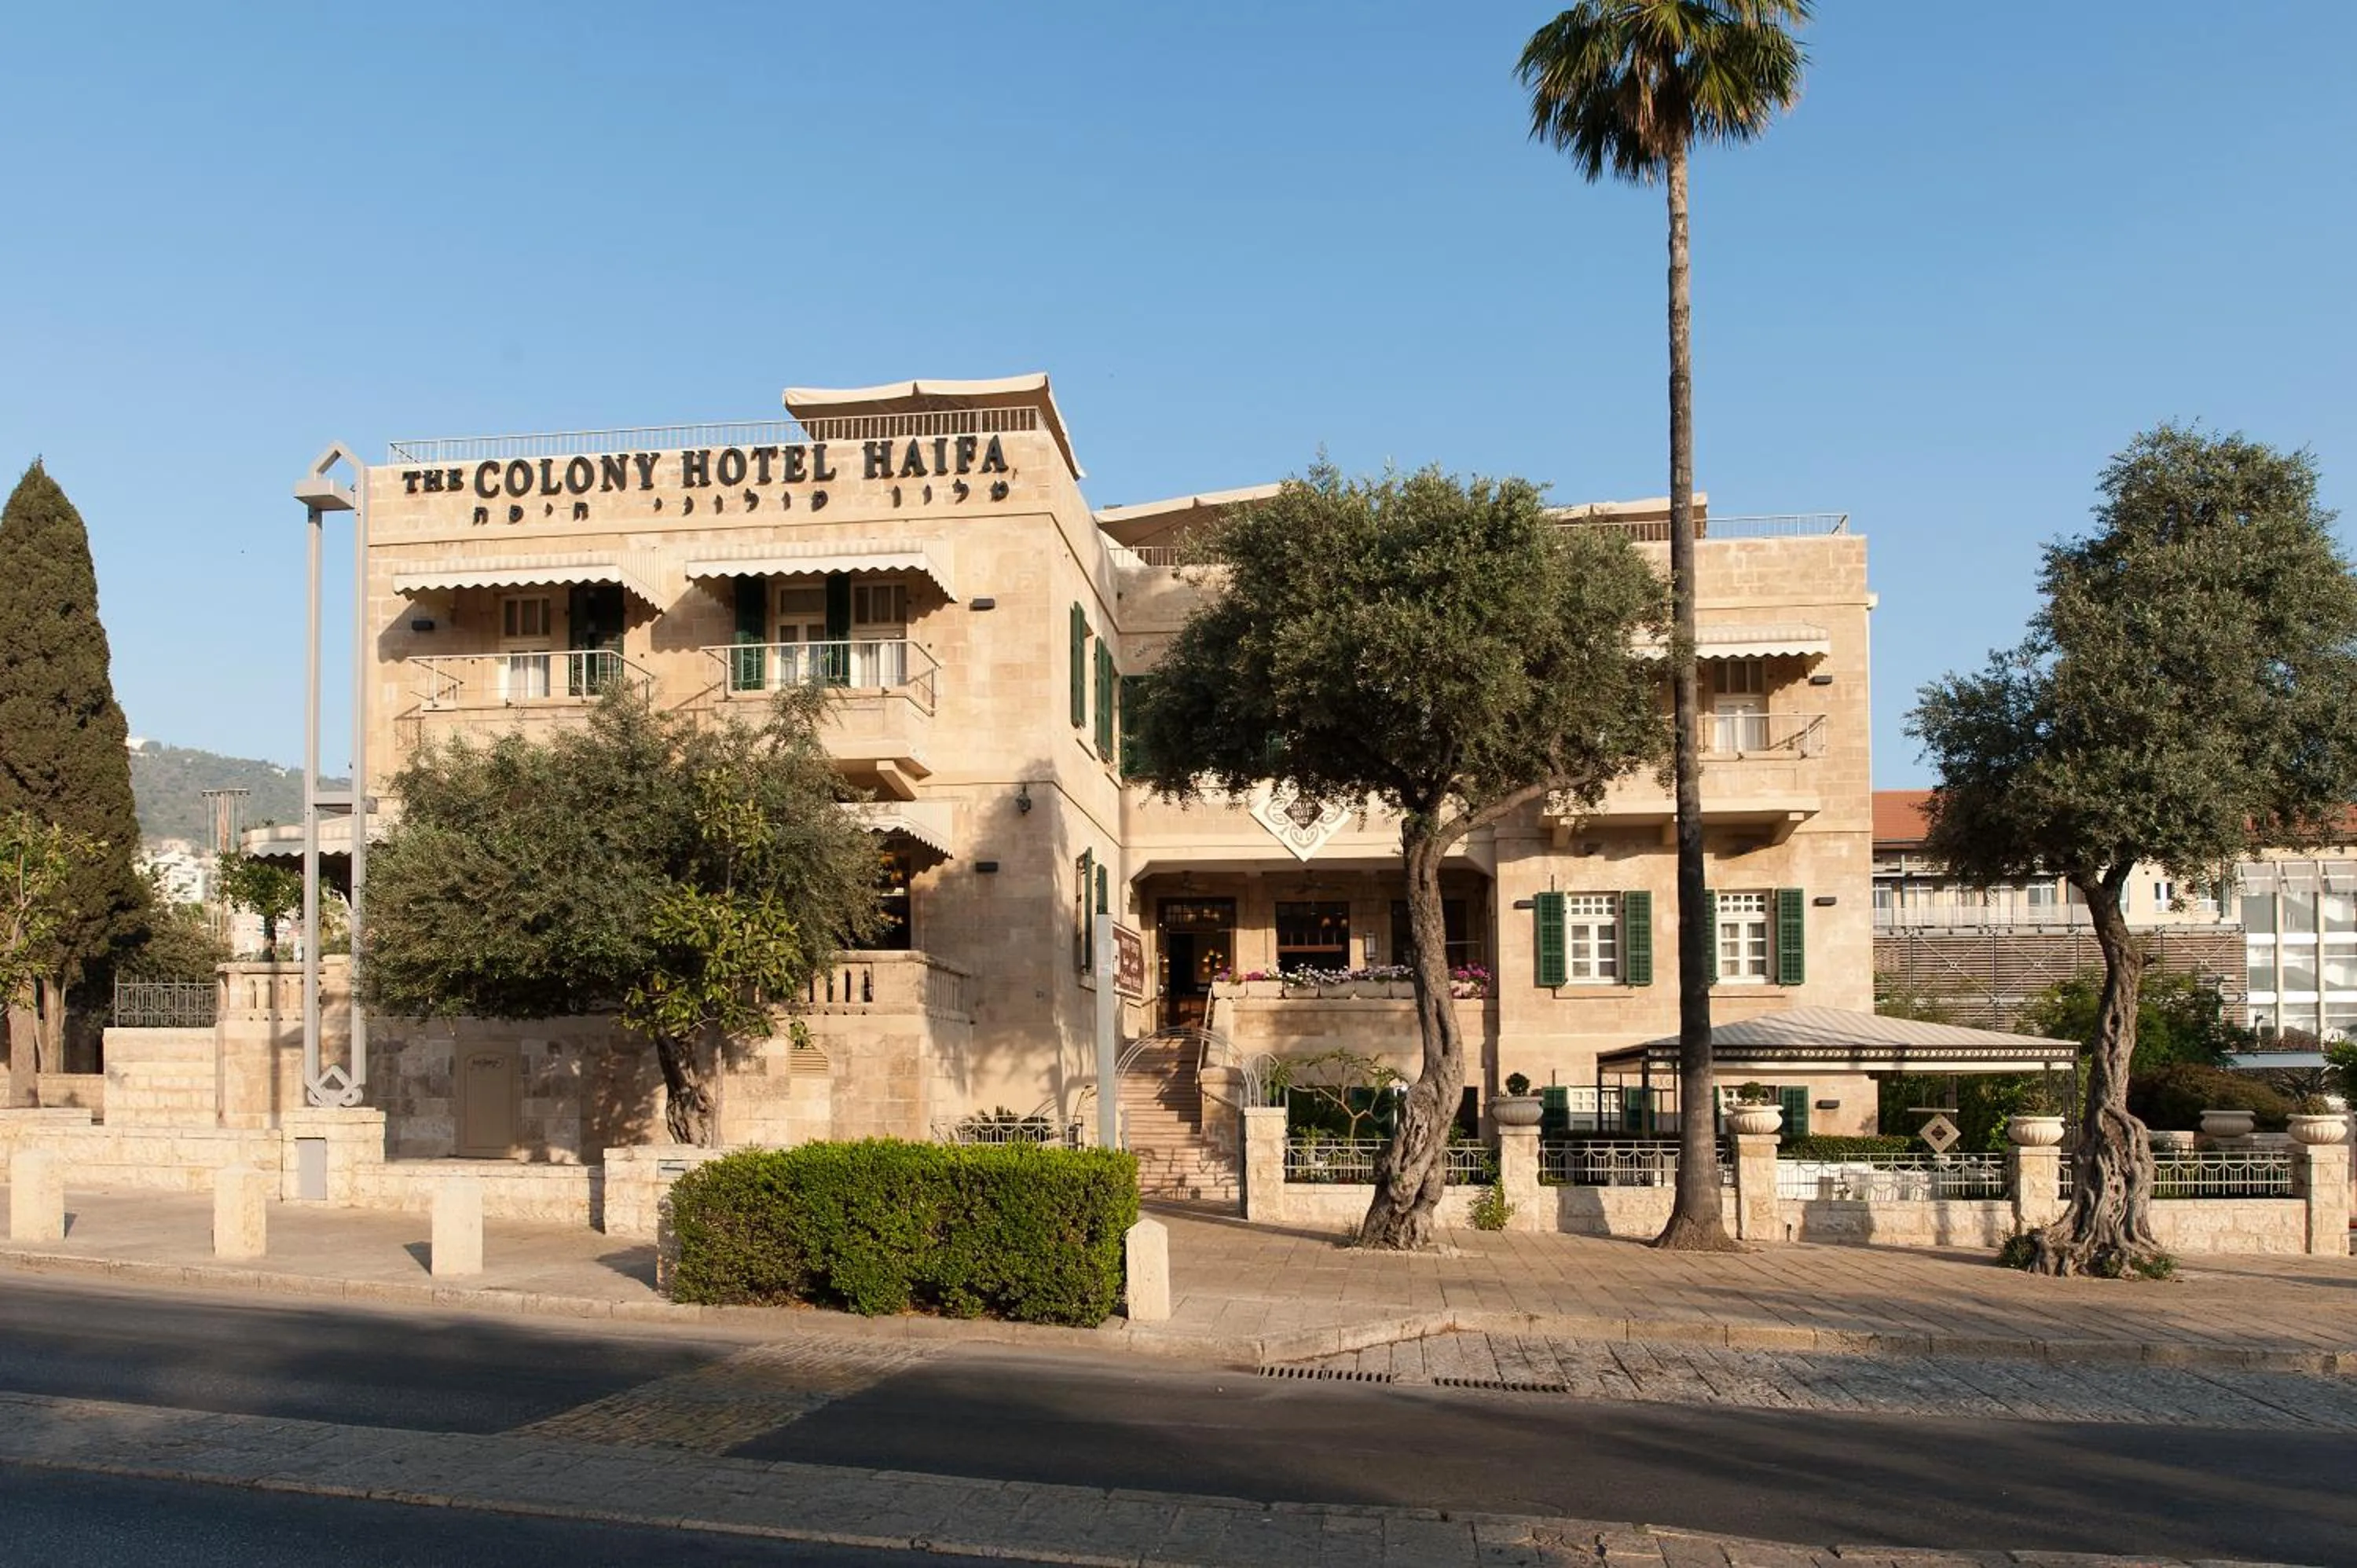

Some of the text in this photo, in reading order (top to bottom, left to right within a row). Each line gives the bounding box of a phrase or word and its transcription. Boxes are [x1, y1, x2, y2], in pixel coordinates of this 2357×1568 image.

[401, 434, 1010, 499] THE COLONY HOTEL HAIFA
[471, 478, 1010, 526] מלון קולוני חיפה
